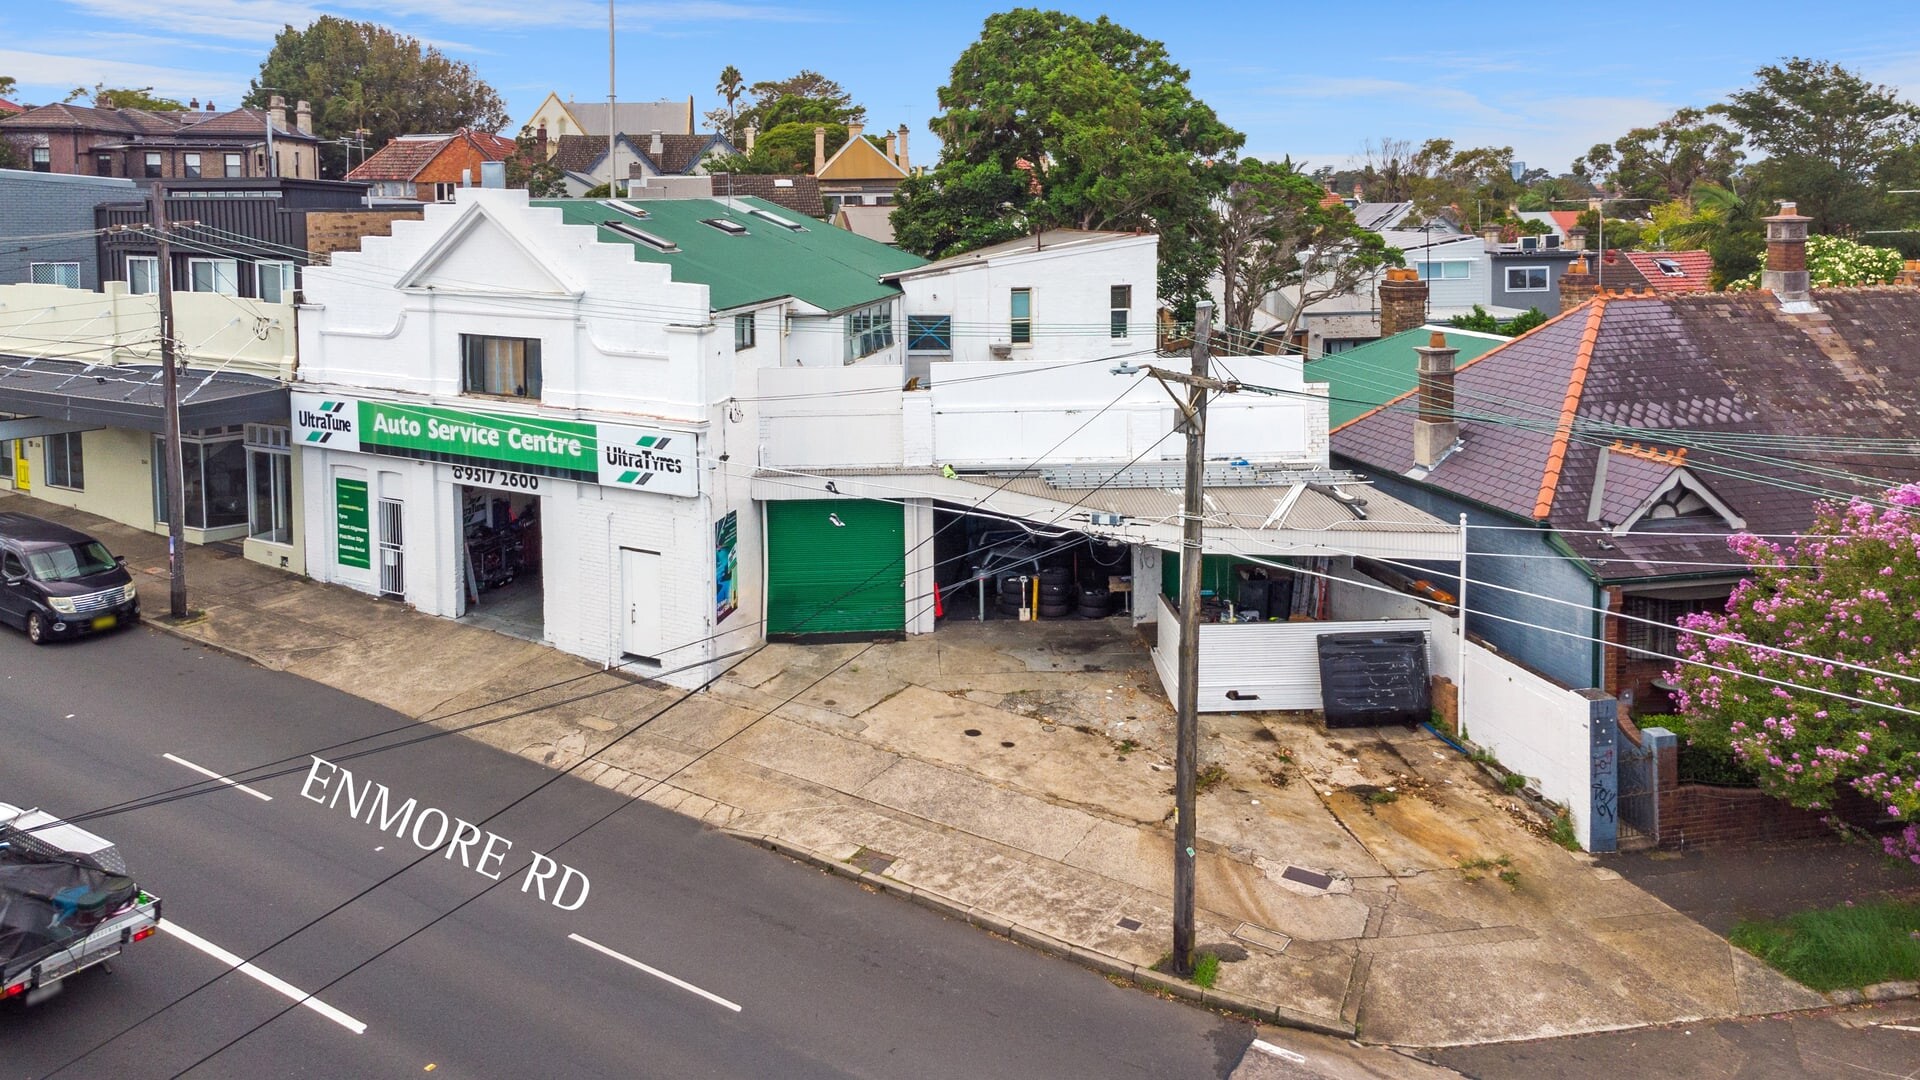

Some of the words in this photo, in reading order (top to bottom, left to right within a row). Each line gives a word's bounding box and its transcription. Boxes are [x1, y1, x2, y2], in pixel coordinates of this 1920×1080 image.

[298, 410, 351, 432] UltraTune
[373, 413, 421, 437] Auto
[428, 418, 500, 447] Service
[508, 427, 582, 457] Centre
[606, 446, 682, 473] UltraTyres
[465, 467, 496, 484] 9517
[500, 471, 539, 490] 2600
